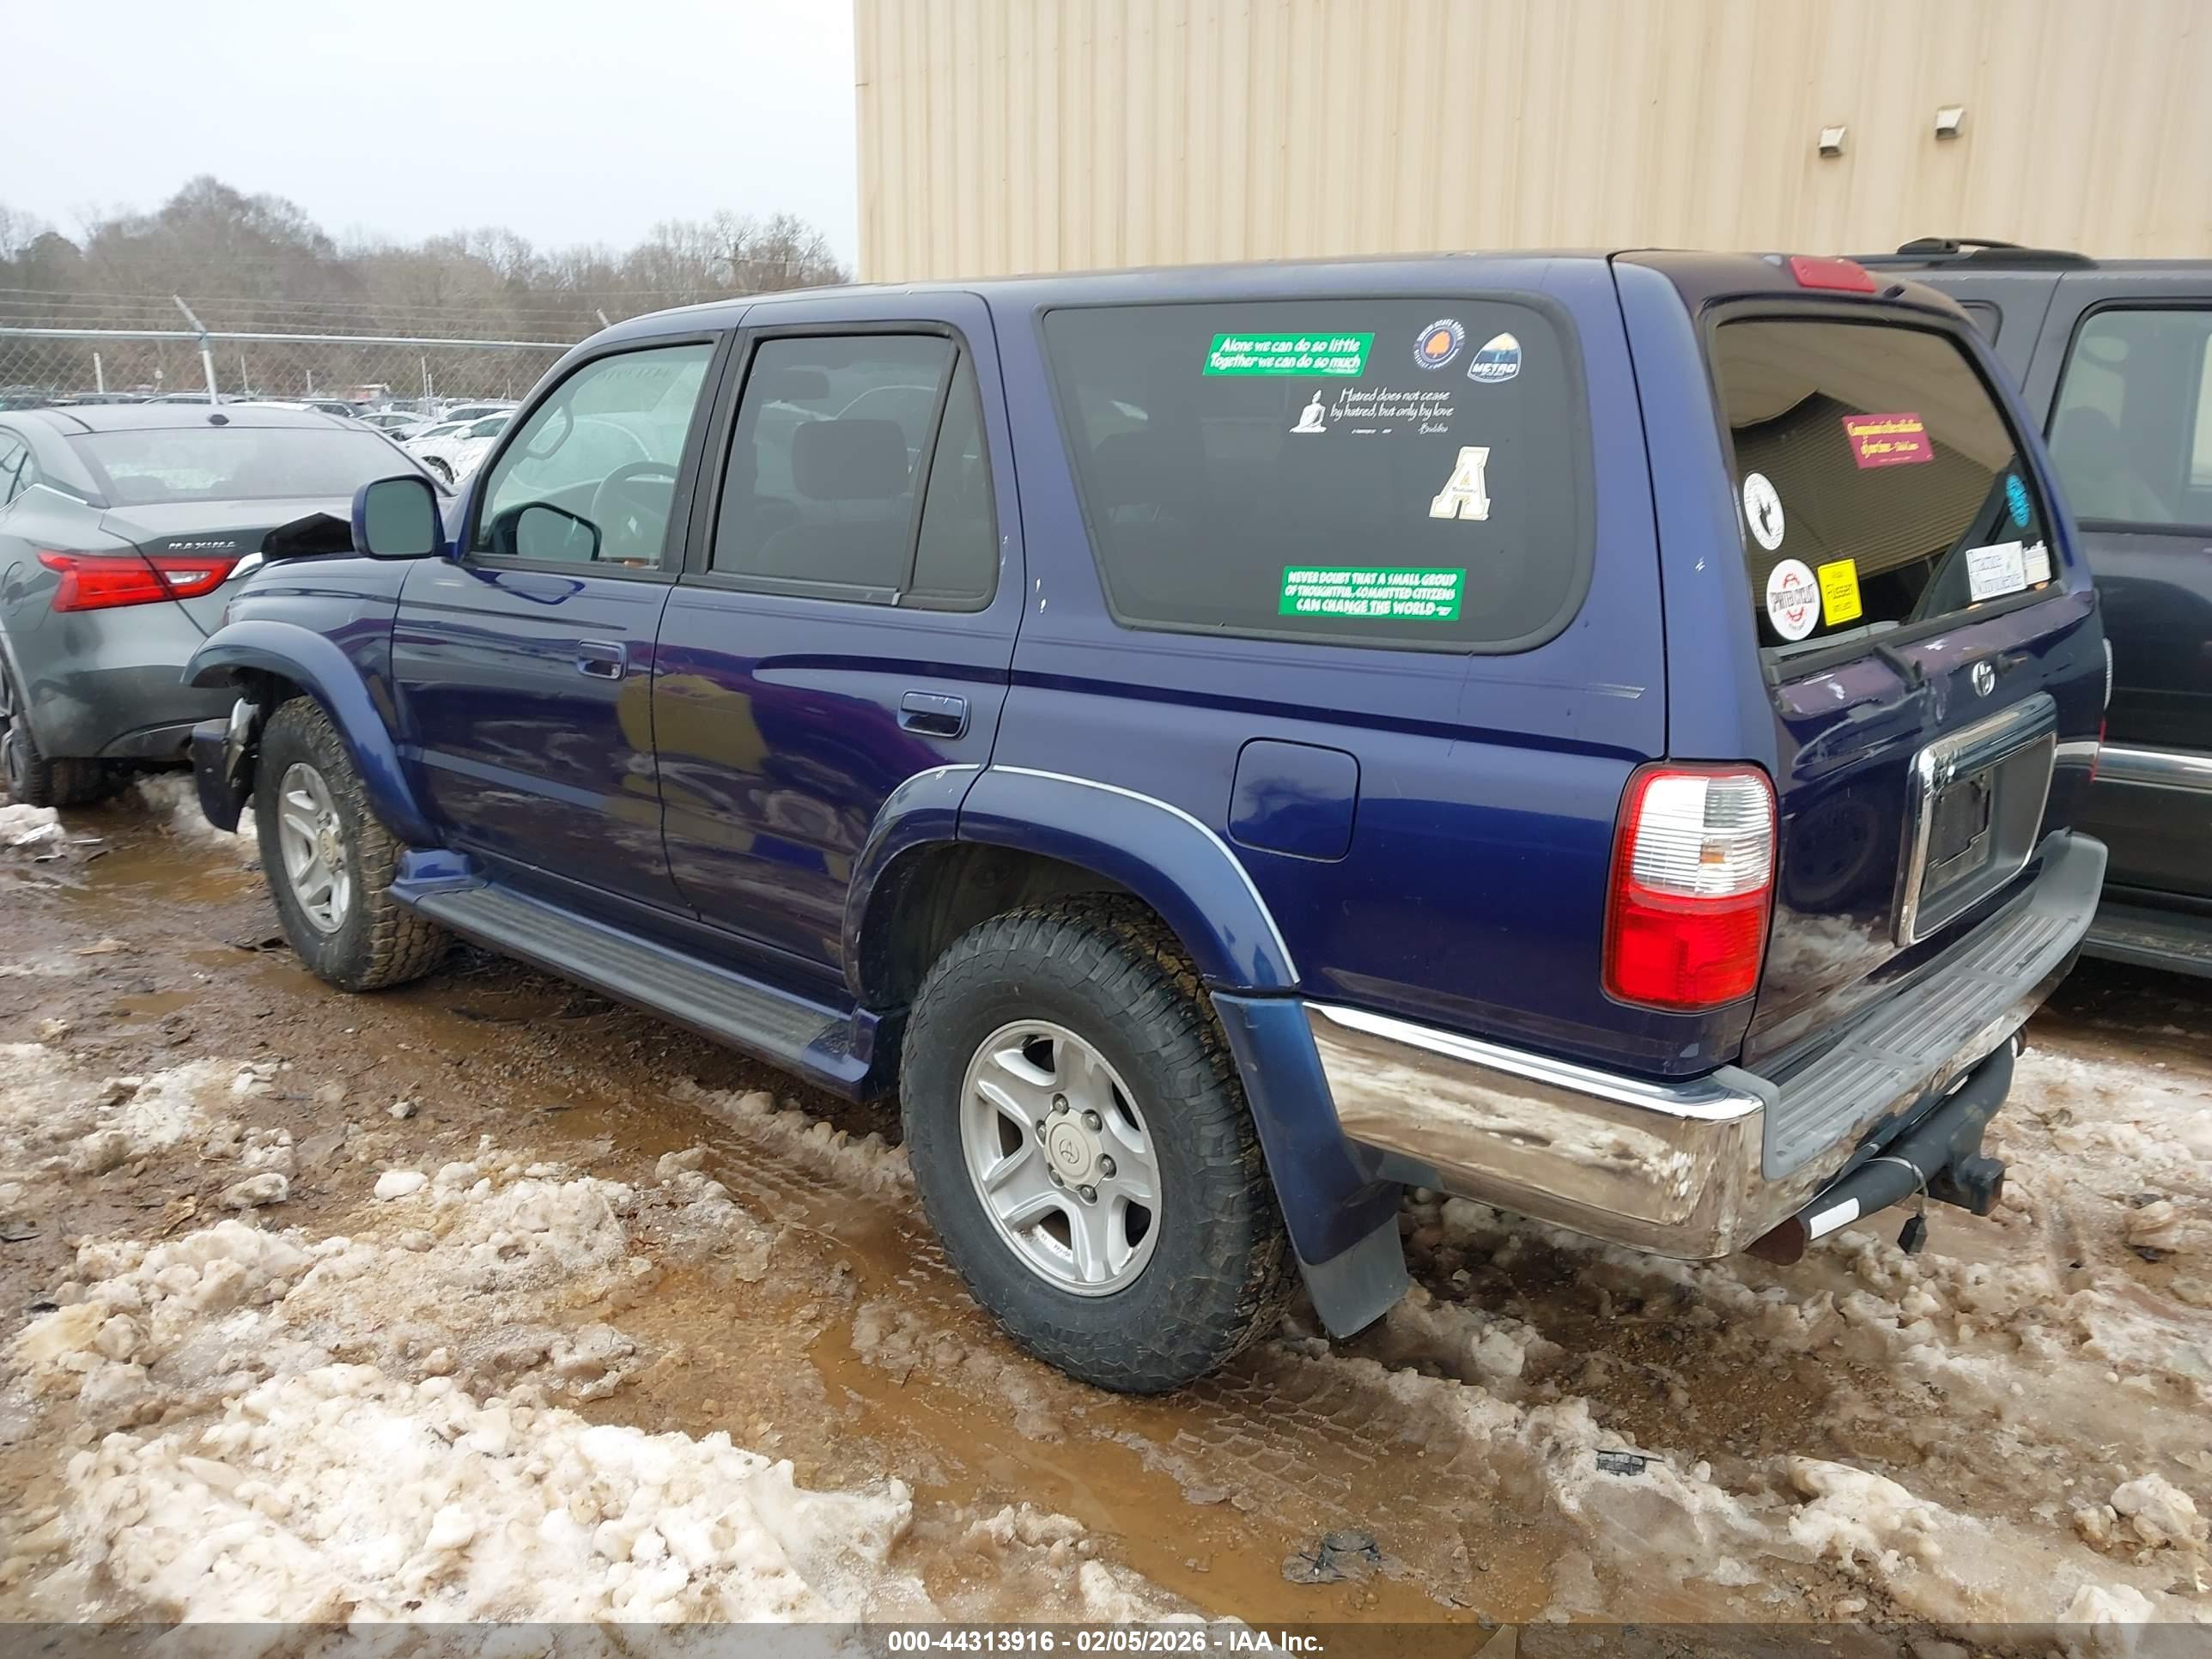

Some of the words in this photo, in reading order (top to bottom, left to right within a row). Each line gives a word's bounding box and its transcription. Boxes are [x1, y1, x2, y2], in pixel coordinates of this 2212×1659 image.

[1219, 337, 1254, 352] Alone
[1254, 341, 1271, 352] we
[1271, 340, 1293, 353] can
[1294, 337, 1310, 352] do
[1310, 340, 1328, 352] so
[1328, 337, 1361, 352] little
[1210, 352, 1257, 370] Together
[1257, 356, 1274, 368] we
[1274, 356, 1296, 368] can
[1296, 353, 1313, 368] do
[1313, 356, 1329, 368] so
[1328, 354, 1361, 369] much
[1472, 362, 1517, 374] METRO
[1340, 387, 1378, 404] Hatred
[1376, 386, 1401, 401] does
[1401, 390, 1420, 401] not
[1420, 392, 1450, 401] cease
[1330, 403, 1343, 422] by
[1343, 402, 1377, 419] hatred,
[1377, 402, 1397, 416] but
[1396, 401, 1418, 422] only
[1419, 401, 1433, 421] by
[1432, 401, 1455, 416] love
[1429, 446, 1491, 520] A
[1287, 571, 1319, 583] NEVER
[1319, 572, 1351, 584] DOUBT
[1352, 572, 1377, 585] THAT
[1376, 573, 1386, 585] A
[1388, 573, 1420, 586] SMALL
[1421, 574, 1457, 586] GROUP
[1285, 585, 1297, 597] OF
[1353, 586, 1412, 599] COMMITTED
[1412, 587, 1455, 600] CITIZENS
[1296, 599, 1322, 611] CAN
[1322, 599, 1369, 614] CHANGE
[1369, 600, 1391, 614] THE
[1392, 601, 1437, 616] WORLD
